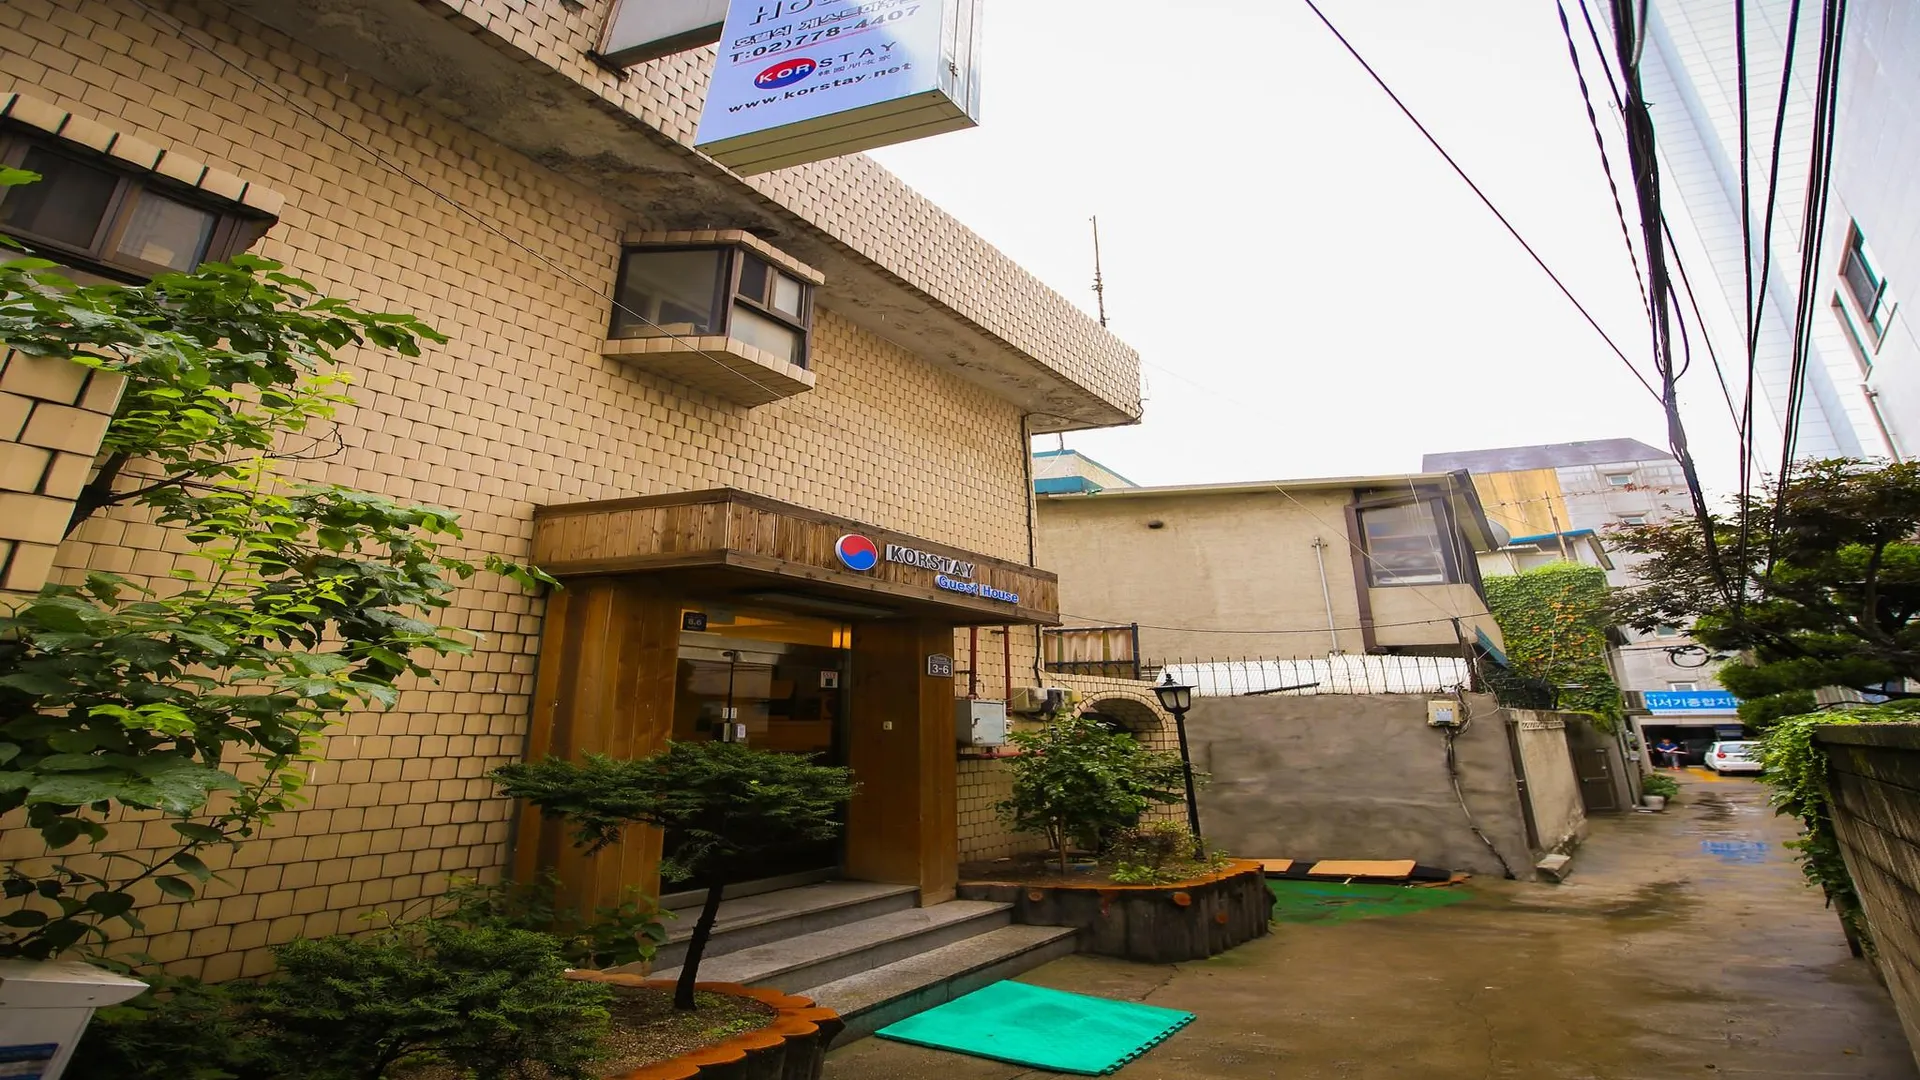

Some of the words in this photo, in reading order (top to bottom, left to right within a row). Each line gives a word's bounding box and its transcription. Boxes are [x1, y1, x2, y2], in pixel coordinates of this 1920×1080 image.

[728, 62, 912, 113] www.korstay.net
[887, 544, 974, 578] KORSTAY
[936, 574, 979, 595] Guest
[981, 583, 1020, 604] House
[932, 663, 949, 674] 3-6
